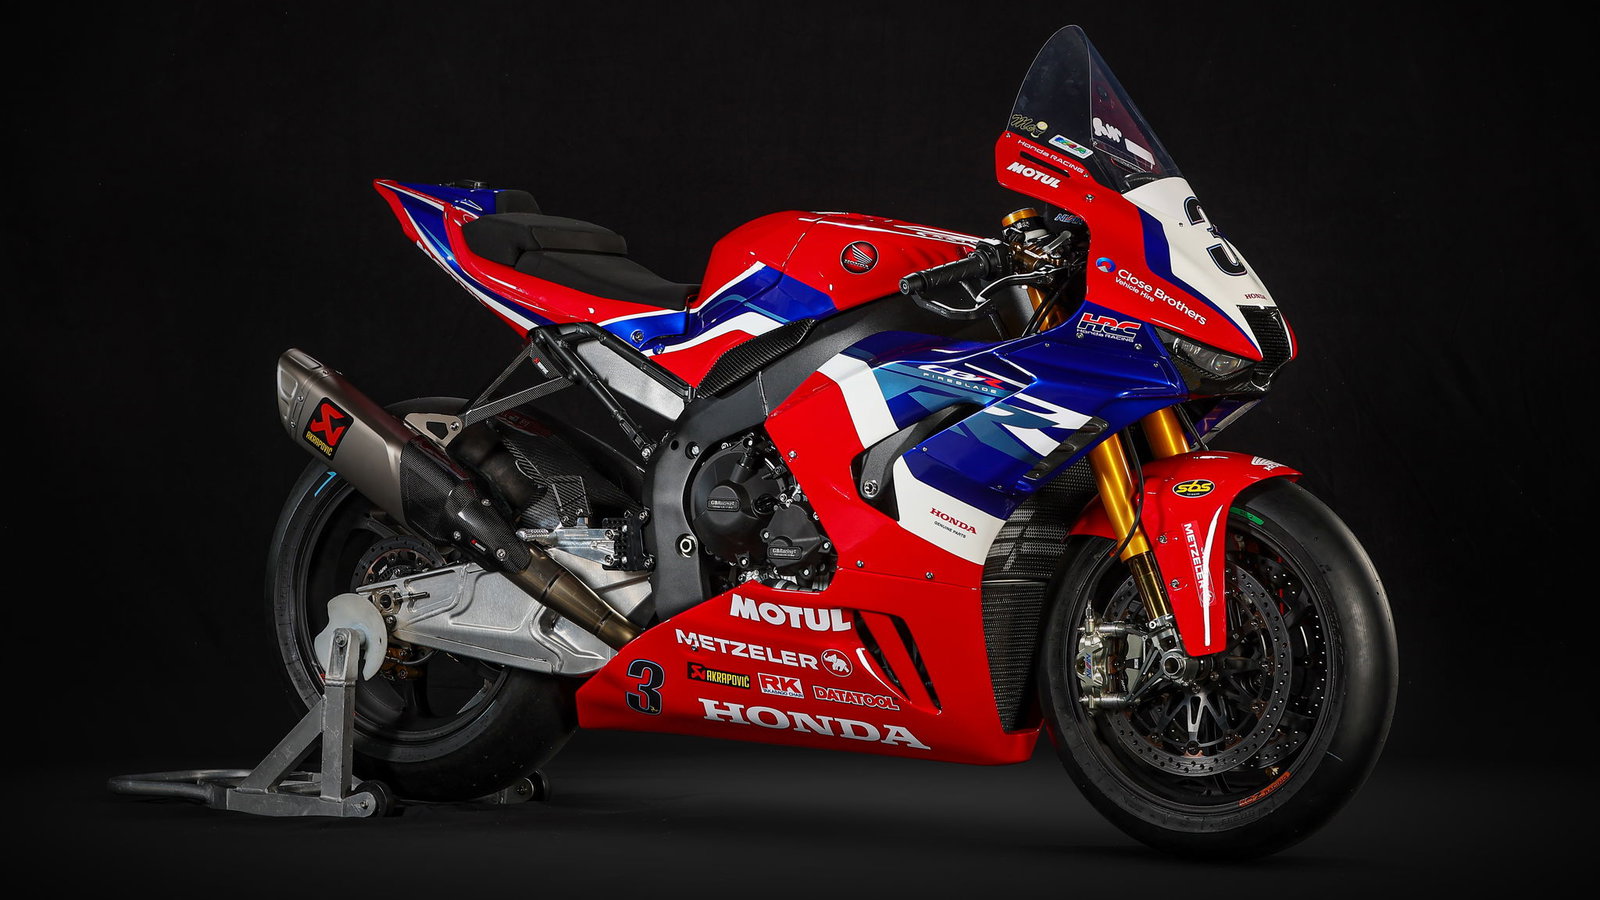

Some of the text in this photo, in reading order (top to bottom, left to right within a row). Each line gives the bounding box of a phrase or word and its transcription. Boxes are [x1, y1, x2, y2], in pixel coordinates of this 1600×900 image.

[1017, 139, 1050, 158] Honda
[1049, 154, 1085, 174] RACING
[1006, 161, 1062, 189] MOTUL
[1115, 276, 1155, 303] Vehicle Hire
[1117, 269, 1207, 326] Close Brothers
[1076, 312, 1142, 340] HRC
[922, 372, 998, 395] FIREBLADE
[929, 507, 977, 535] HONDA
[729, 593, 852, 632] MOTUL
[675, 628, 820, 671] METZELER
[625, 658, 666, 716] 3
[759, 673, 802, 694] RK
[812, 685, 901, 711] DATATOOL
[698, 697, 933, 751] HONDA
